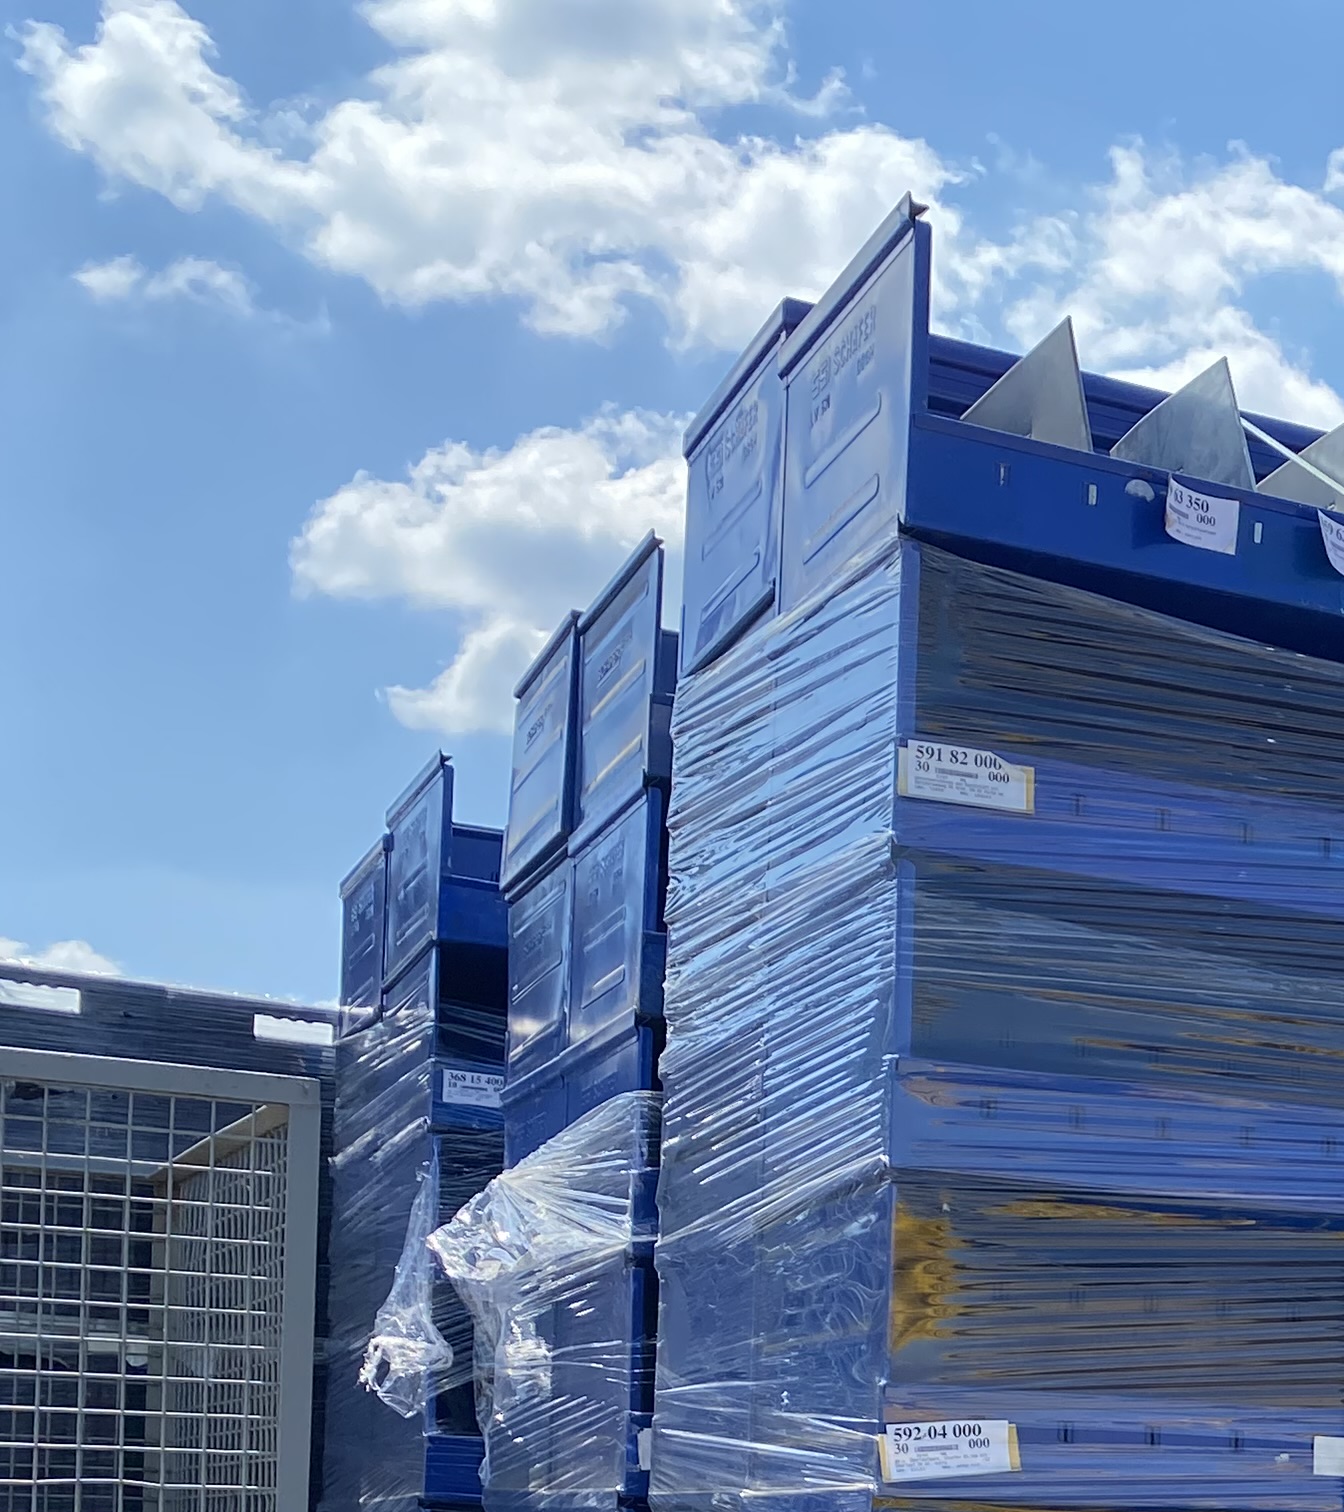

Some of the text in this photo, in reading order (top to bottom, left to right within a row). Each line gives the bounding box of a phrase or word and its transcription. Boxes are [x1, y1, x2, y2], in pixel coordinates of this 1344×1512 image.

[1173, 489, 1183, 505] 63
[1185, 494, 1210, 513] 350
[1197, 513, 1216, 527] 000
[915, 745, 942, 762] 591
[949, 749, 968, 765] 82
[915, 760, 1010, 784] 30 000
[471, 1075, 482, 1084] 15
[893, 1423, 982, 1442] 592 04 000
[894, 1438, 990, 1454] 30 000
